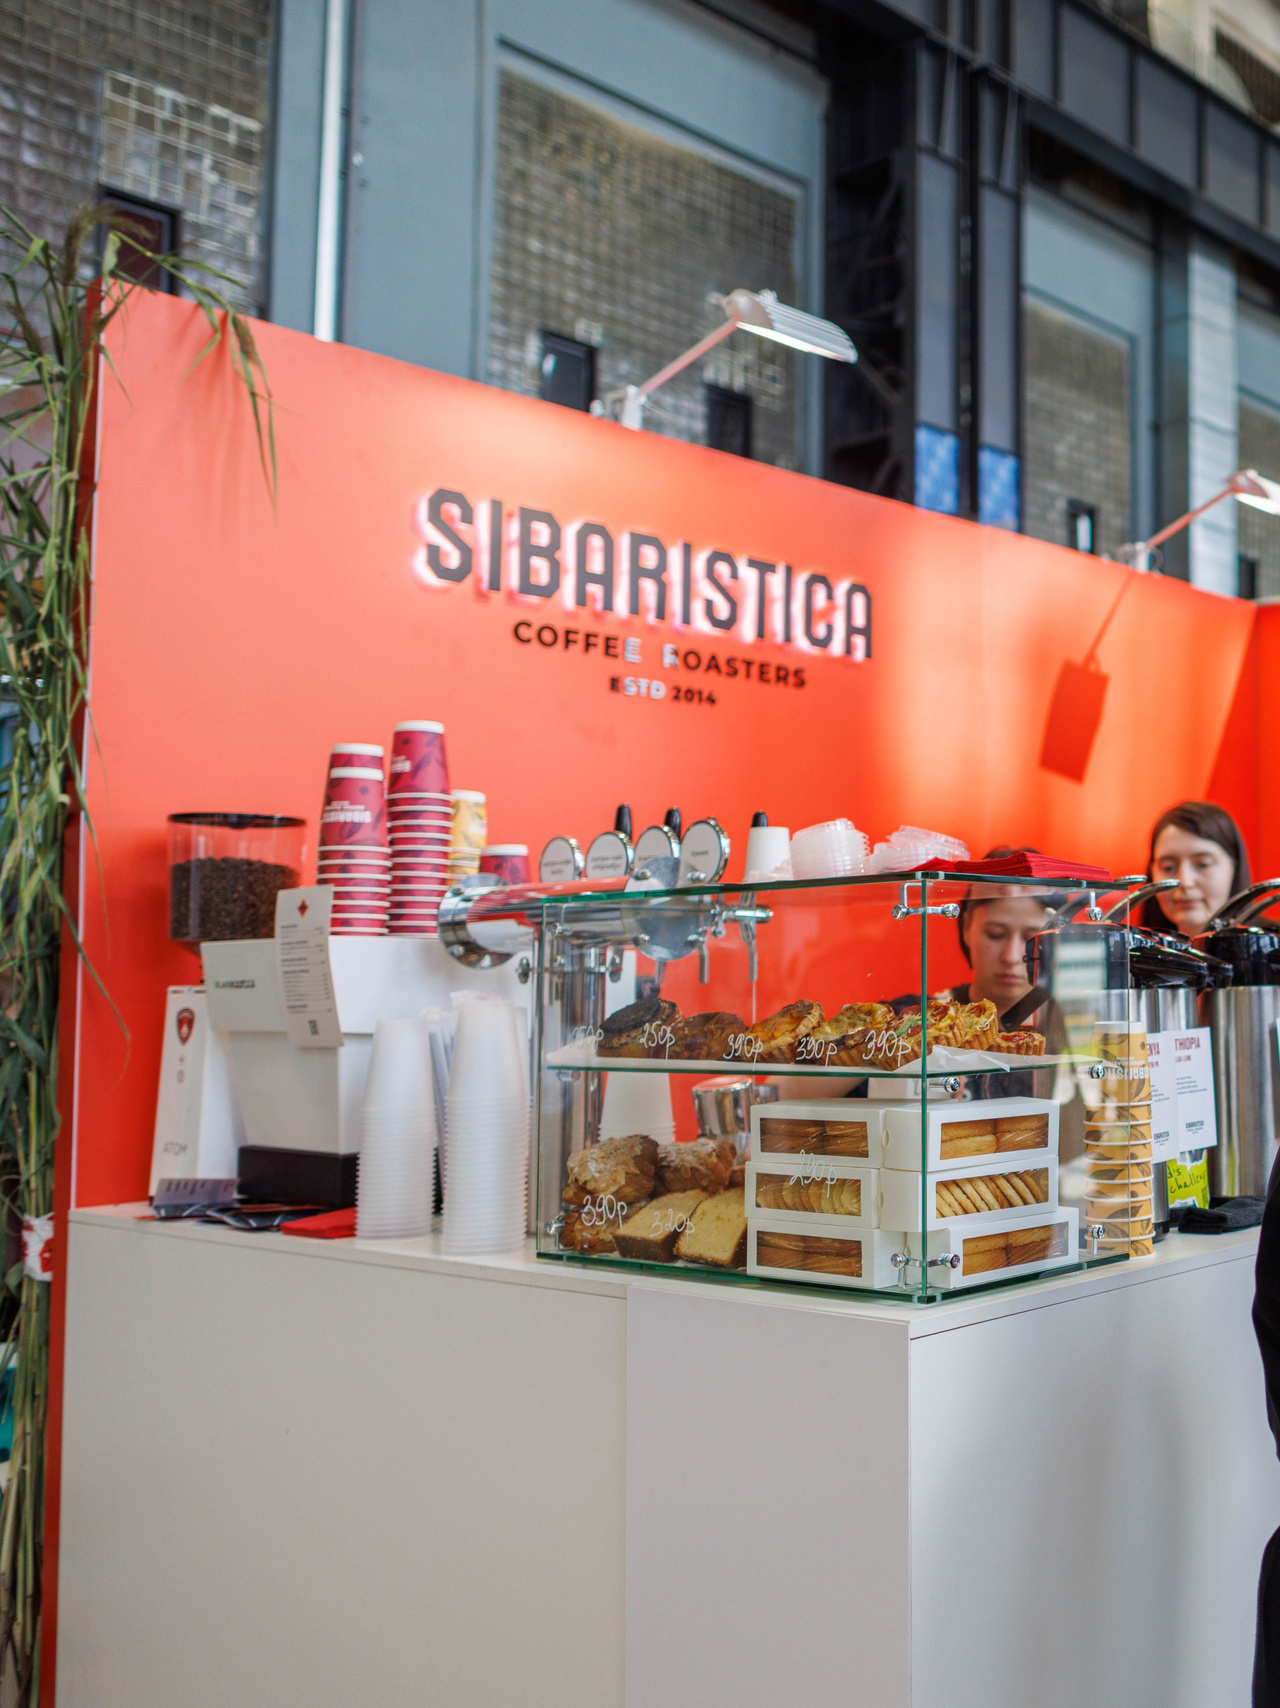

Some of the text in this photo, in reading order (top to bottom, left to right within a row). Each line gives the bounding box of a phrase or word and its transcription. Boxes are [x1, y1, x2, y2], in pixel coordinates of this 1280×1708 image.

[426, 487, 873, 659] SIBARISTICA
[513, 621, 807, 689] COFFEE ROASTERS
[609, 676, 717, 705] ESTD 2014
[1146, 1042, 1160, 1057] ENYA
[1175, 1036, 1200, 1051] THIOPIA
